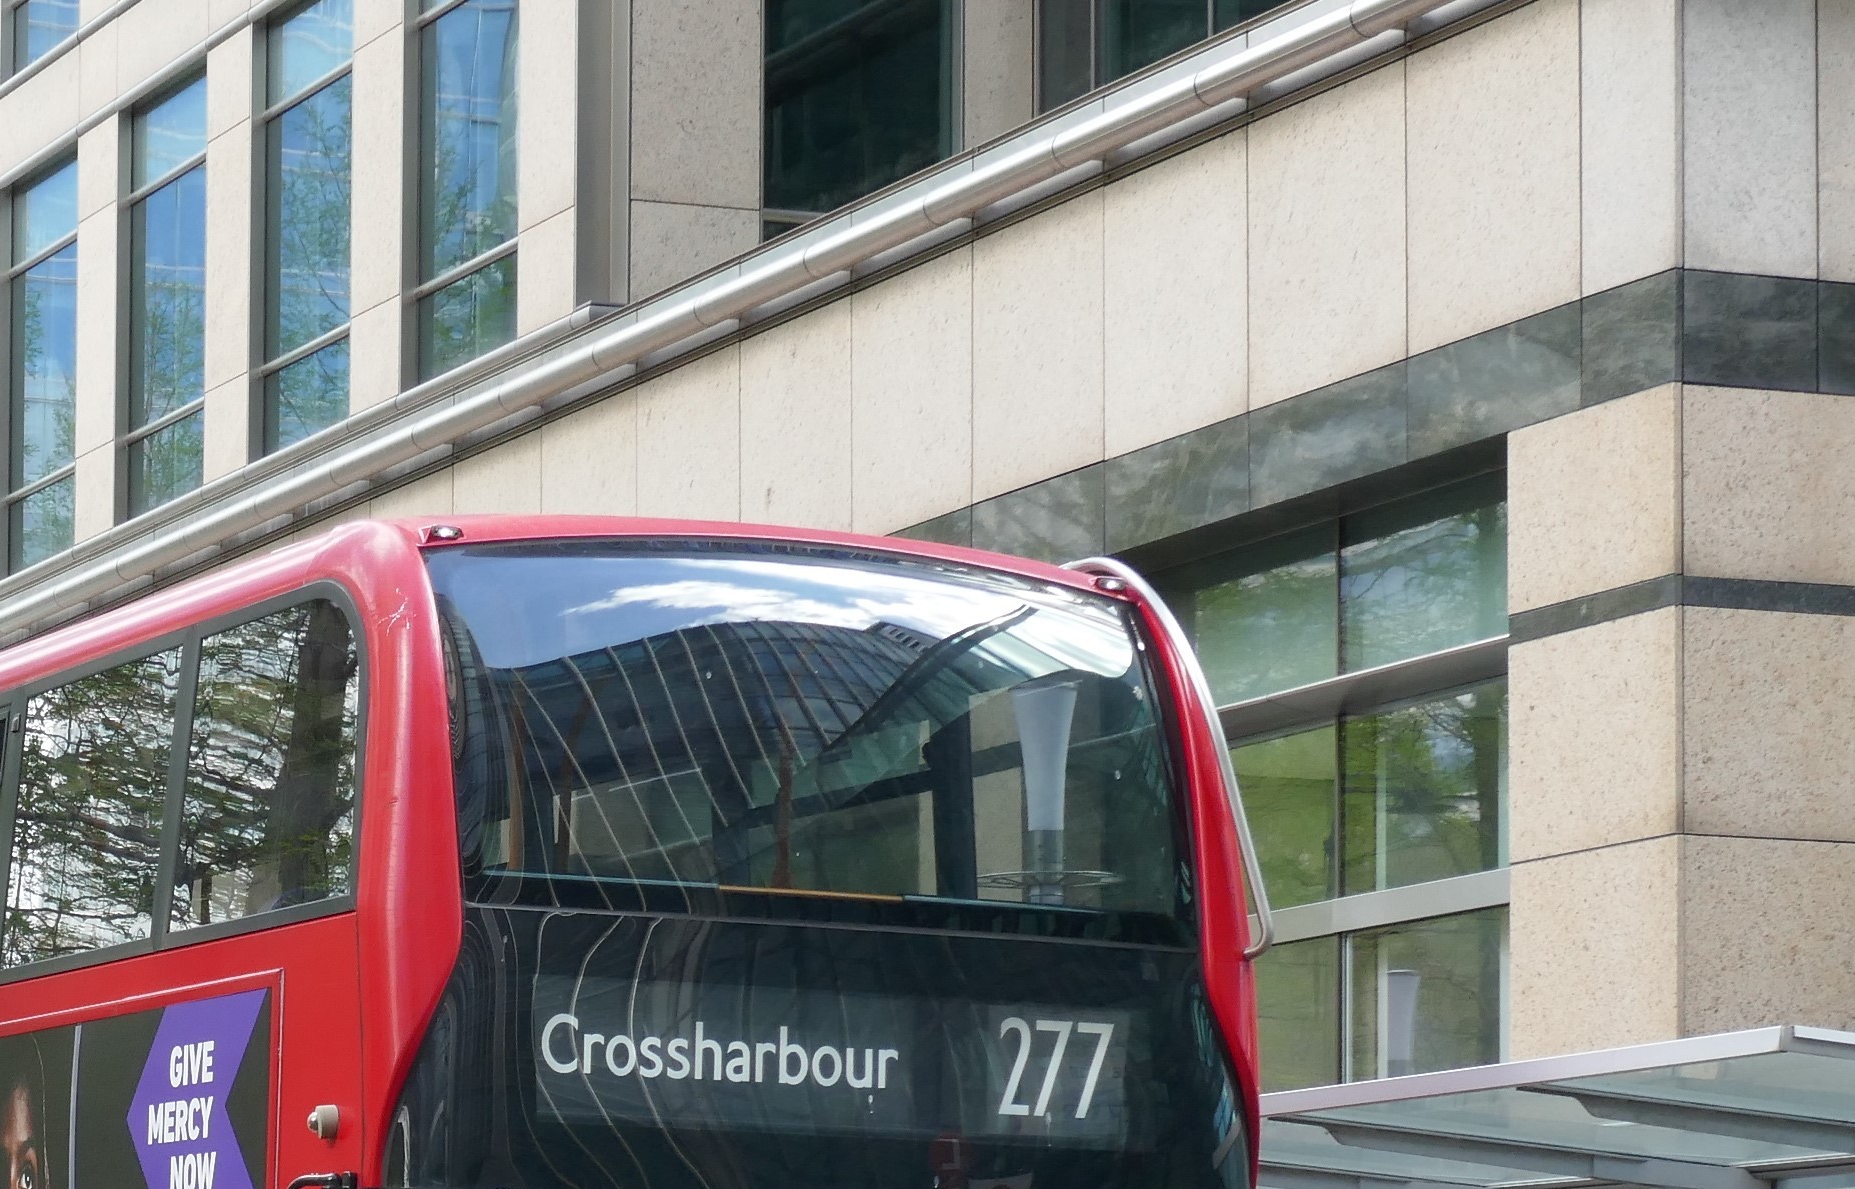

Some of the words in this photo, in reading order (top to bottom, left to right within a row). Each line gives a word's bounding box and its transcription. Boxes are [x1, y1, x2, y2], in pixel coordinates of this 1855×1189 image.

[169, 1040, 215, 1088] GIVE
[541, 1013, 898, 1089] Crossharbour
[998, 1017, 1114, 1118] 277
[148, 1096, 214, 1145] MERCY
